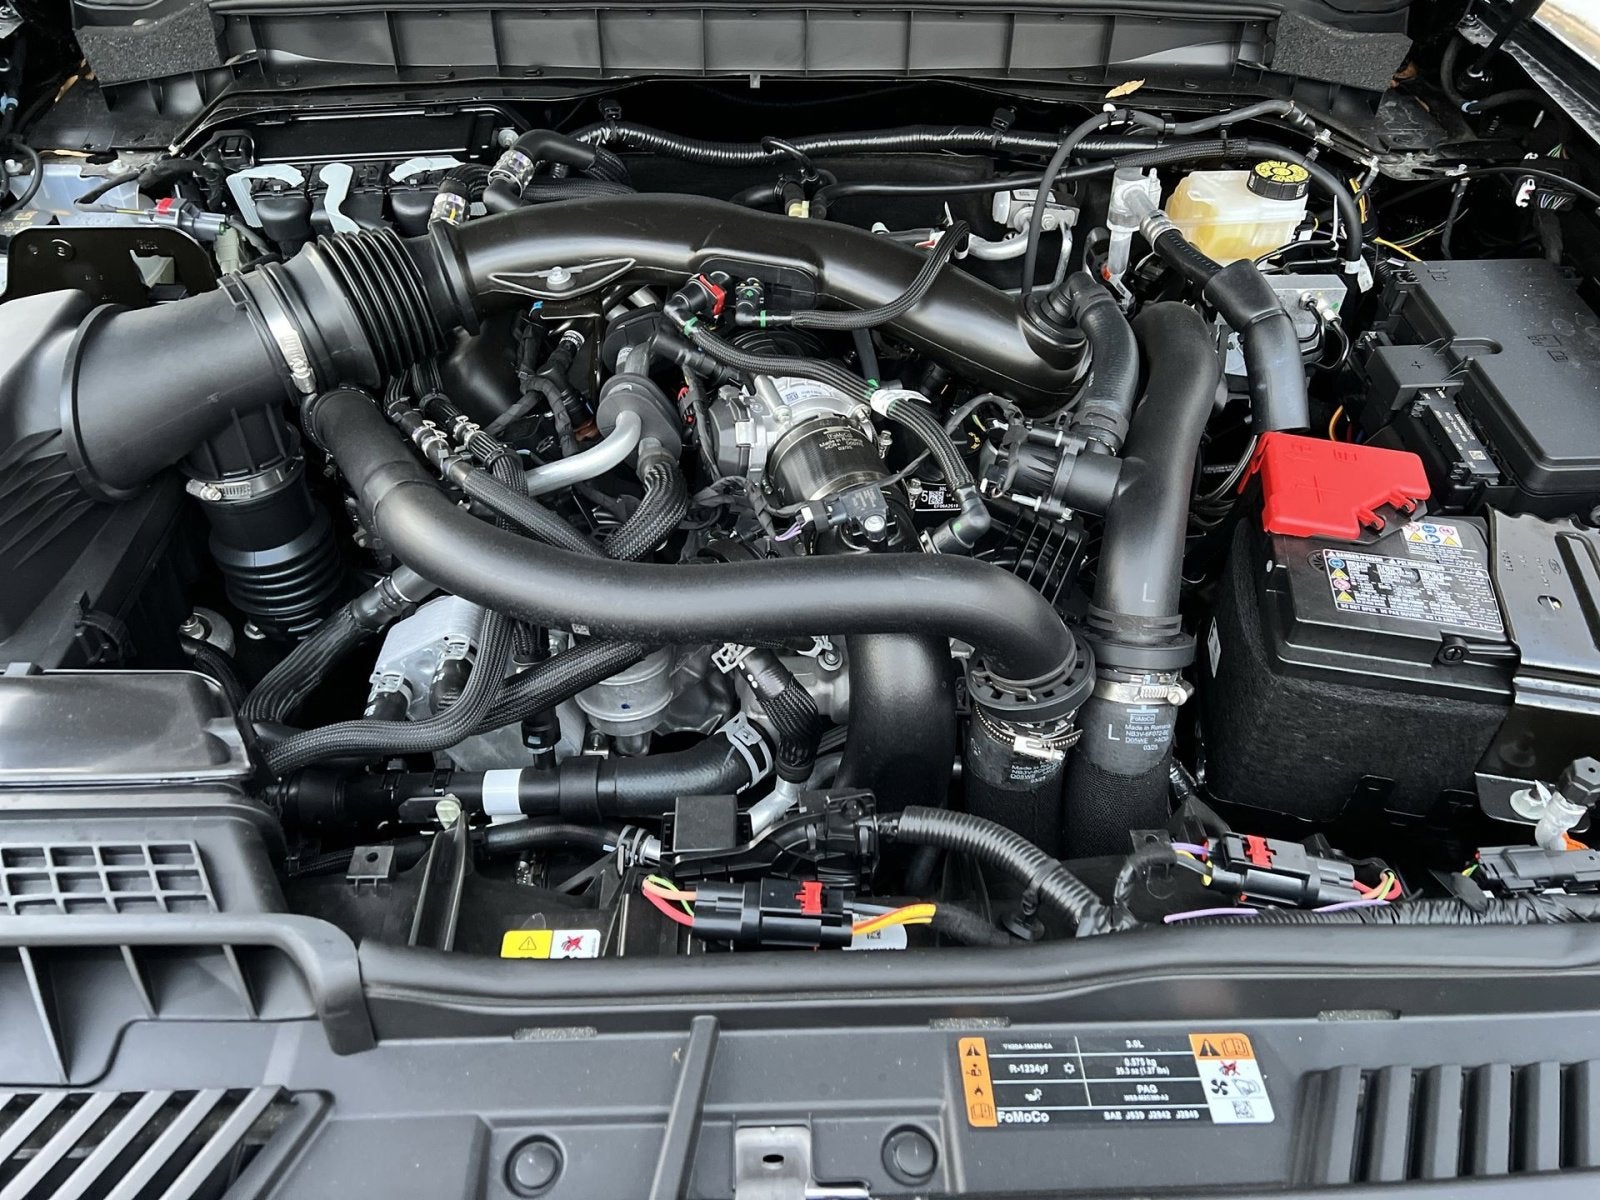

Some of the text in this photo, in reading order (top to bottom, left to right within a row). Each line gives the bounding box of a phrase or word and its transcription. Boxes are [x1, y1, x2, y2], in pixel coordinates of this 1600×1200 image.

[920, 490, 928, 502] 5
[1142, 582, 1156, 603] L
[1108, 724, 1120, 741] L
[1008, 1063, 1049, 1075] R-1234yf
[997, 1110, 1050, 1123] FoMoCo
